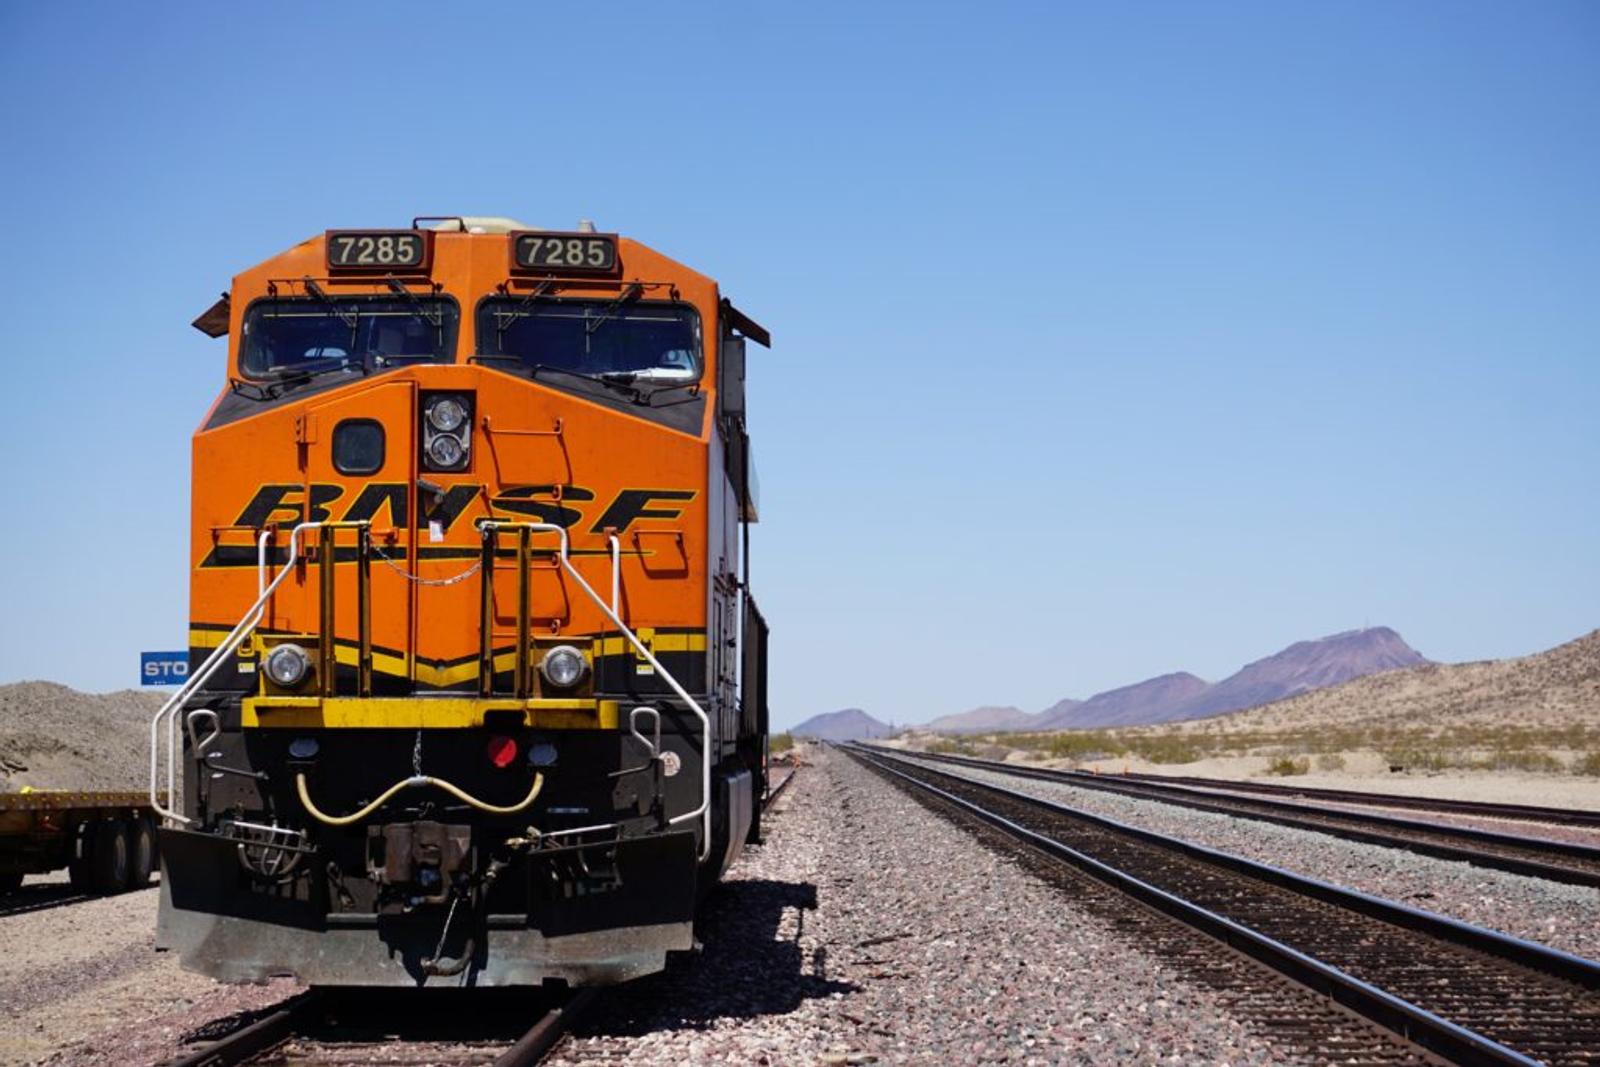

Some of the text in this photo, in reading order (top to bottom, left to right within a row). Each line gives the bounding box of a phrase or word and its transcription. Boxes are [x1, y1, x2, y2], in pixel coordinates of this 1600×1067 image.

[338, 236, 414, 262] 7285
[524, 239, 605, 265] 7285
[232, 482, 698, 534] BNSF
